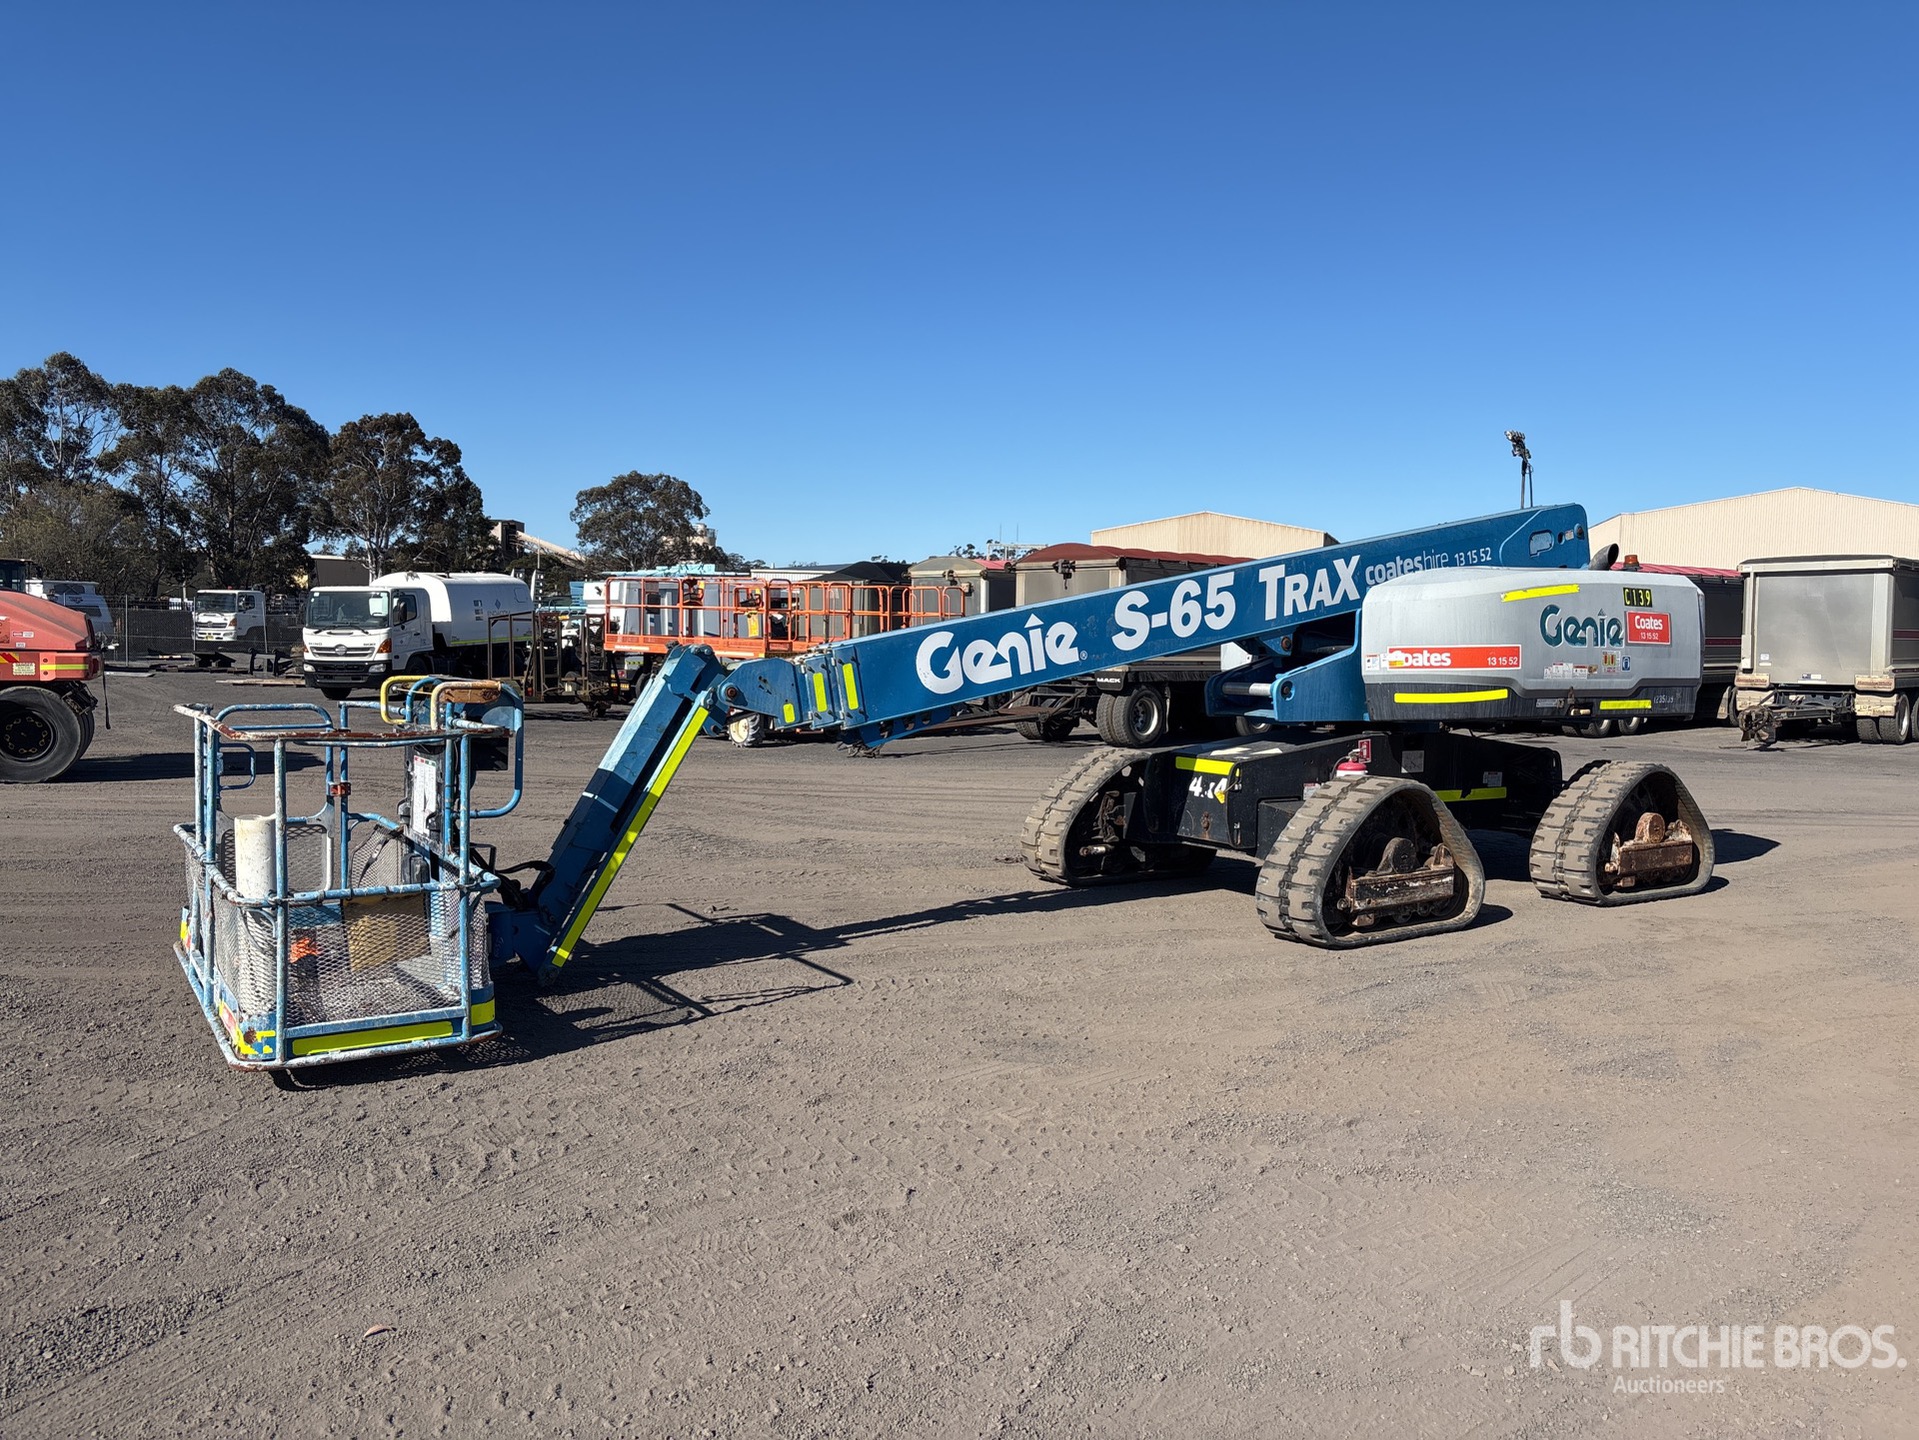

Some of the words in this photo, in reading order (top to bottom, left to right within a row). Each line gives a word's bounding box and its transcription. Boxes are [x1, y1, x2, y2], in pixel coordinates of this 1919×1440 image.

[1365, 549, 1449, 585] coateshire
[1454, 553, 1465, 567] 13
[1467, 550, 1478, 565] 15
[1480, 547, 1492, 562] 52
[916, 613, 1080, 694] Genie
[1112, 572, 1236, 651] S-65
[1540, 604, 1624, 648] Genie
[1634, 615, 1663, 631] Coates
[1641, 632, 1646, 640] 13
[1647, 632, 1652, 640] 15
[1652, 632, 1659, 640] 52
[1390, 650, 1452, 667] oates
[1487, 656, 1497, 666] 13
[1498, 656, 1508, 665] 15
[1508, 656, 1518, 665] 52
